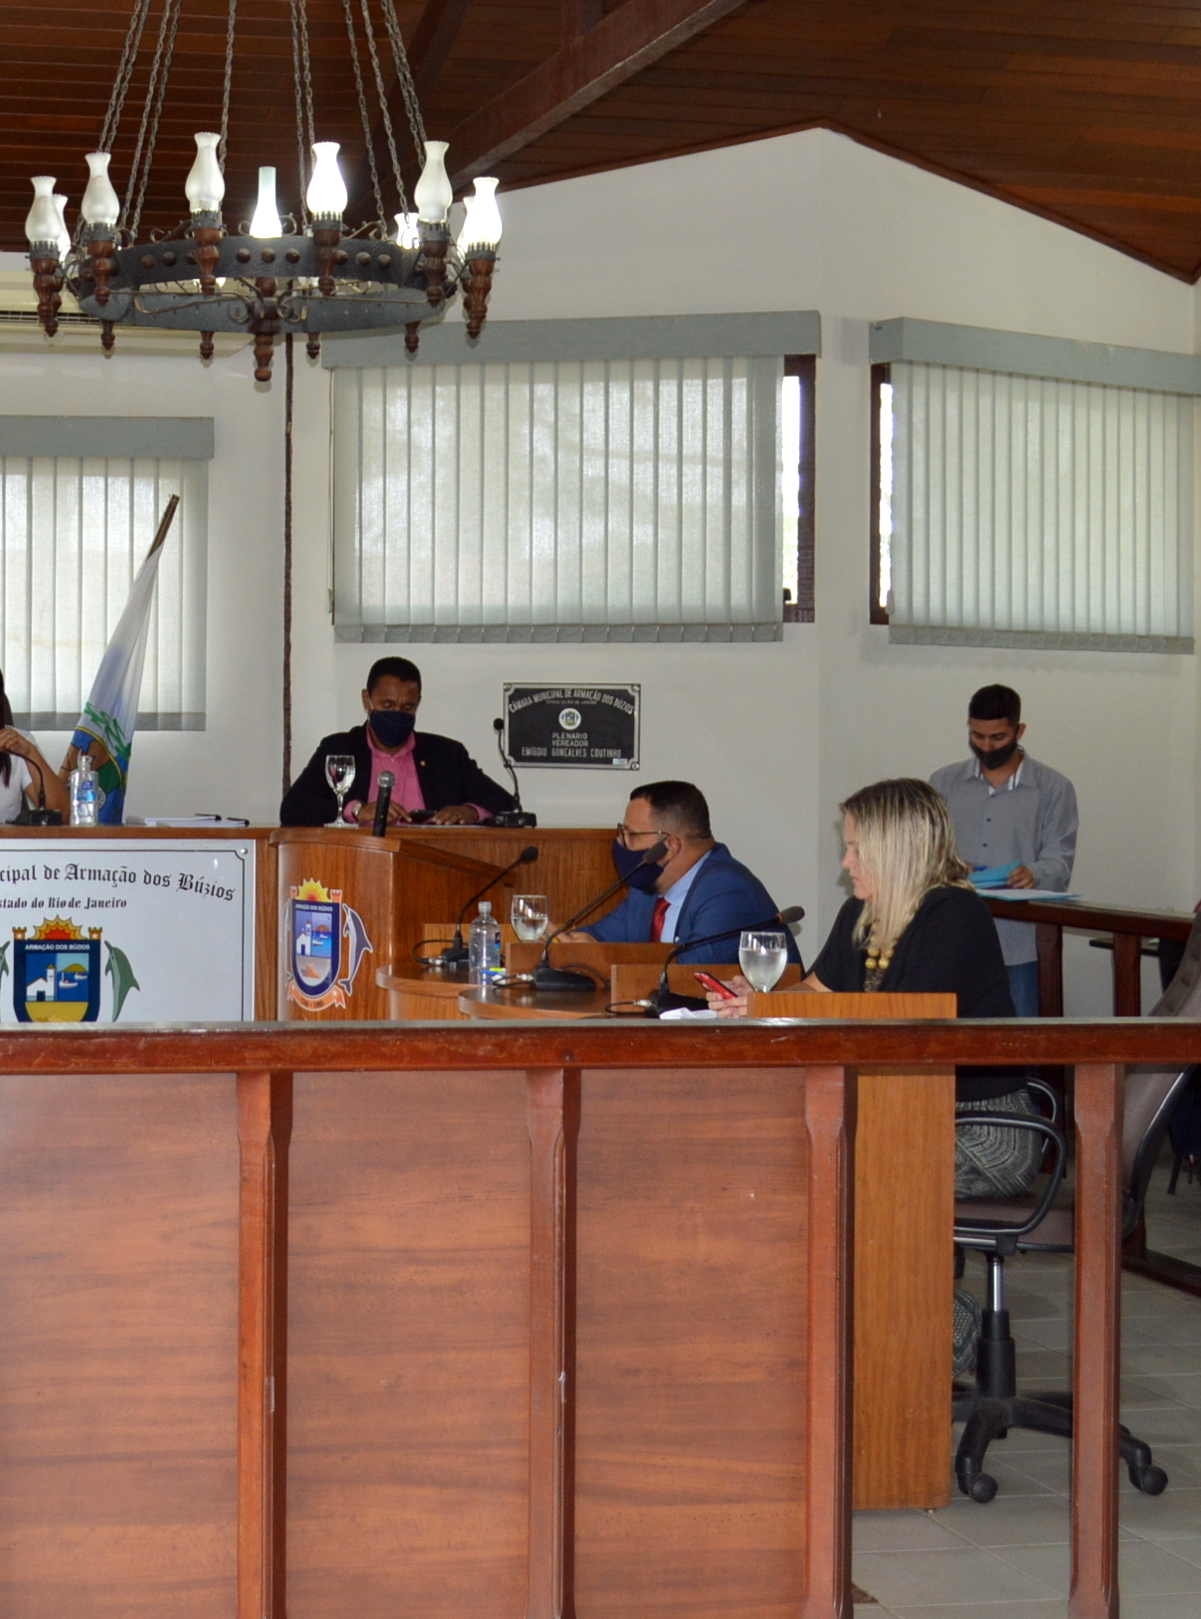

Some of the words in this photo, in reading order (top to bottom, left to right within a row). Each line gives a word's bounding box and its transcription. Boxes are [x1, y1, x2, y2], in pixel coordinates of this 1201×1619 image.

[533, 689, 563, 703] MUNICIPAL
[565, 688, 573, 698] DE
[573, 689, 601, 701] ARMAÇÃO
[601, 693, 615, 706] DOS
[614, 697, 635, 715] BÚZIOS
[552, 739, 588, 747] VEREADOR
[551, 747, 587, 758] GONÇALVES
[590, 748, 622, 758] COUTINHO
[43, 864, 61, 880] de
[64, 863, 137, 887] Armação
[143, 869, 173, 887] dos
[176, 873, 236, 901] Búzios
[31, 897, 44, 909] do
[48, 897, 67, 908] Rio
[68, 897, 81, 908] de
[84, 897, 128, 910] Janeiro
[24, 943, 55, 951] ARMAÇÃO
